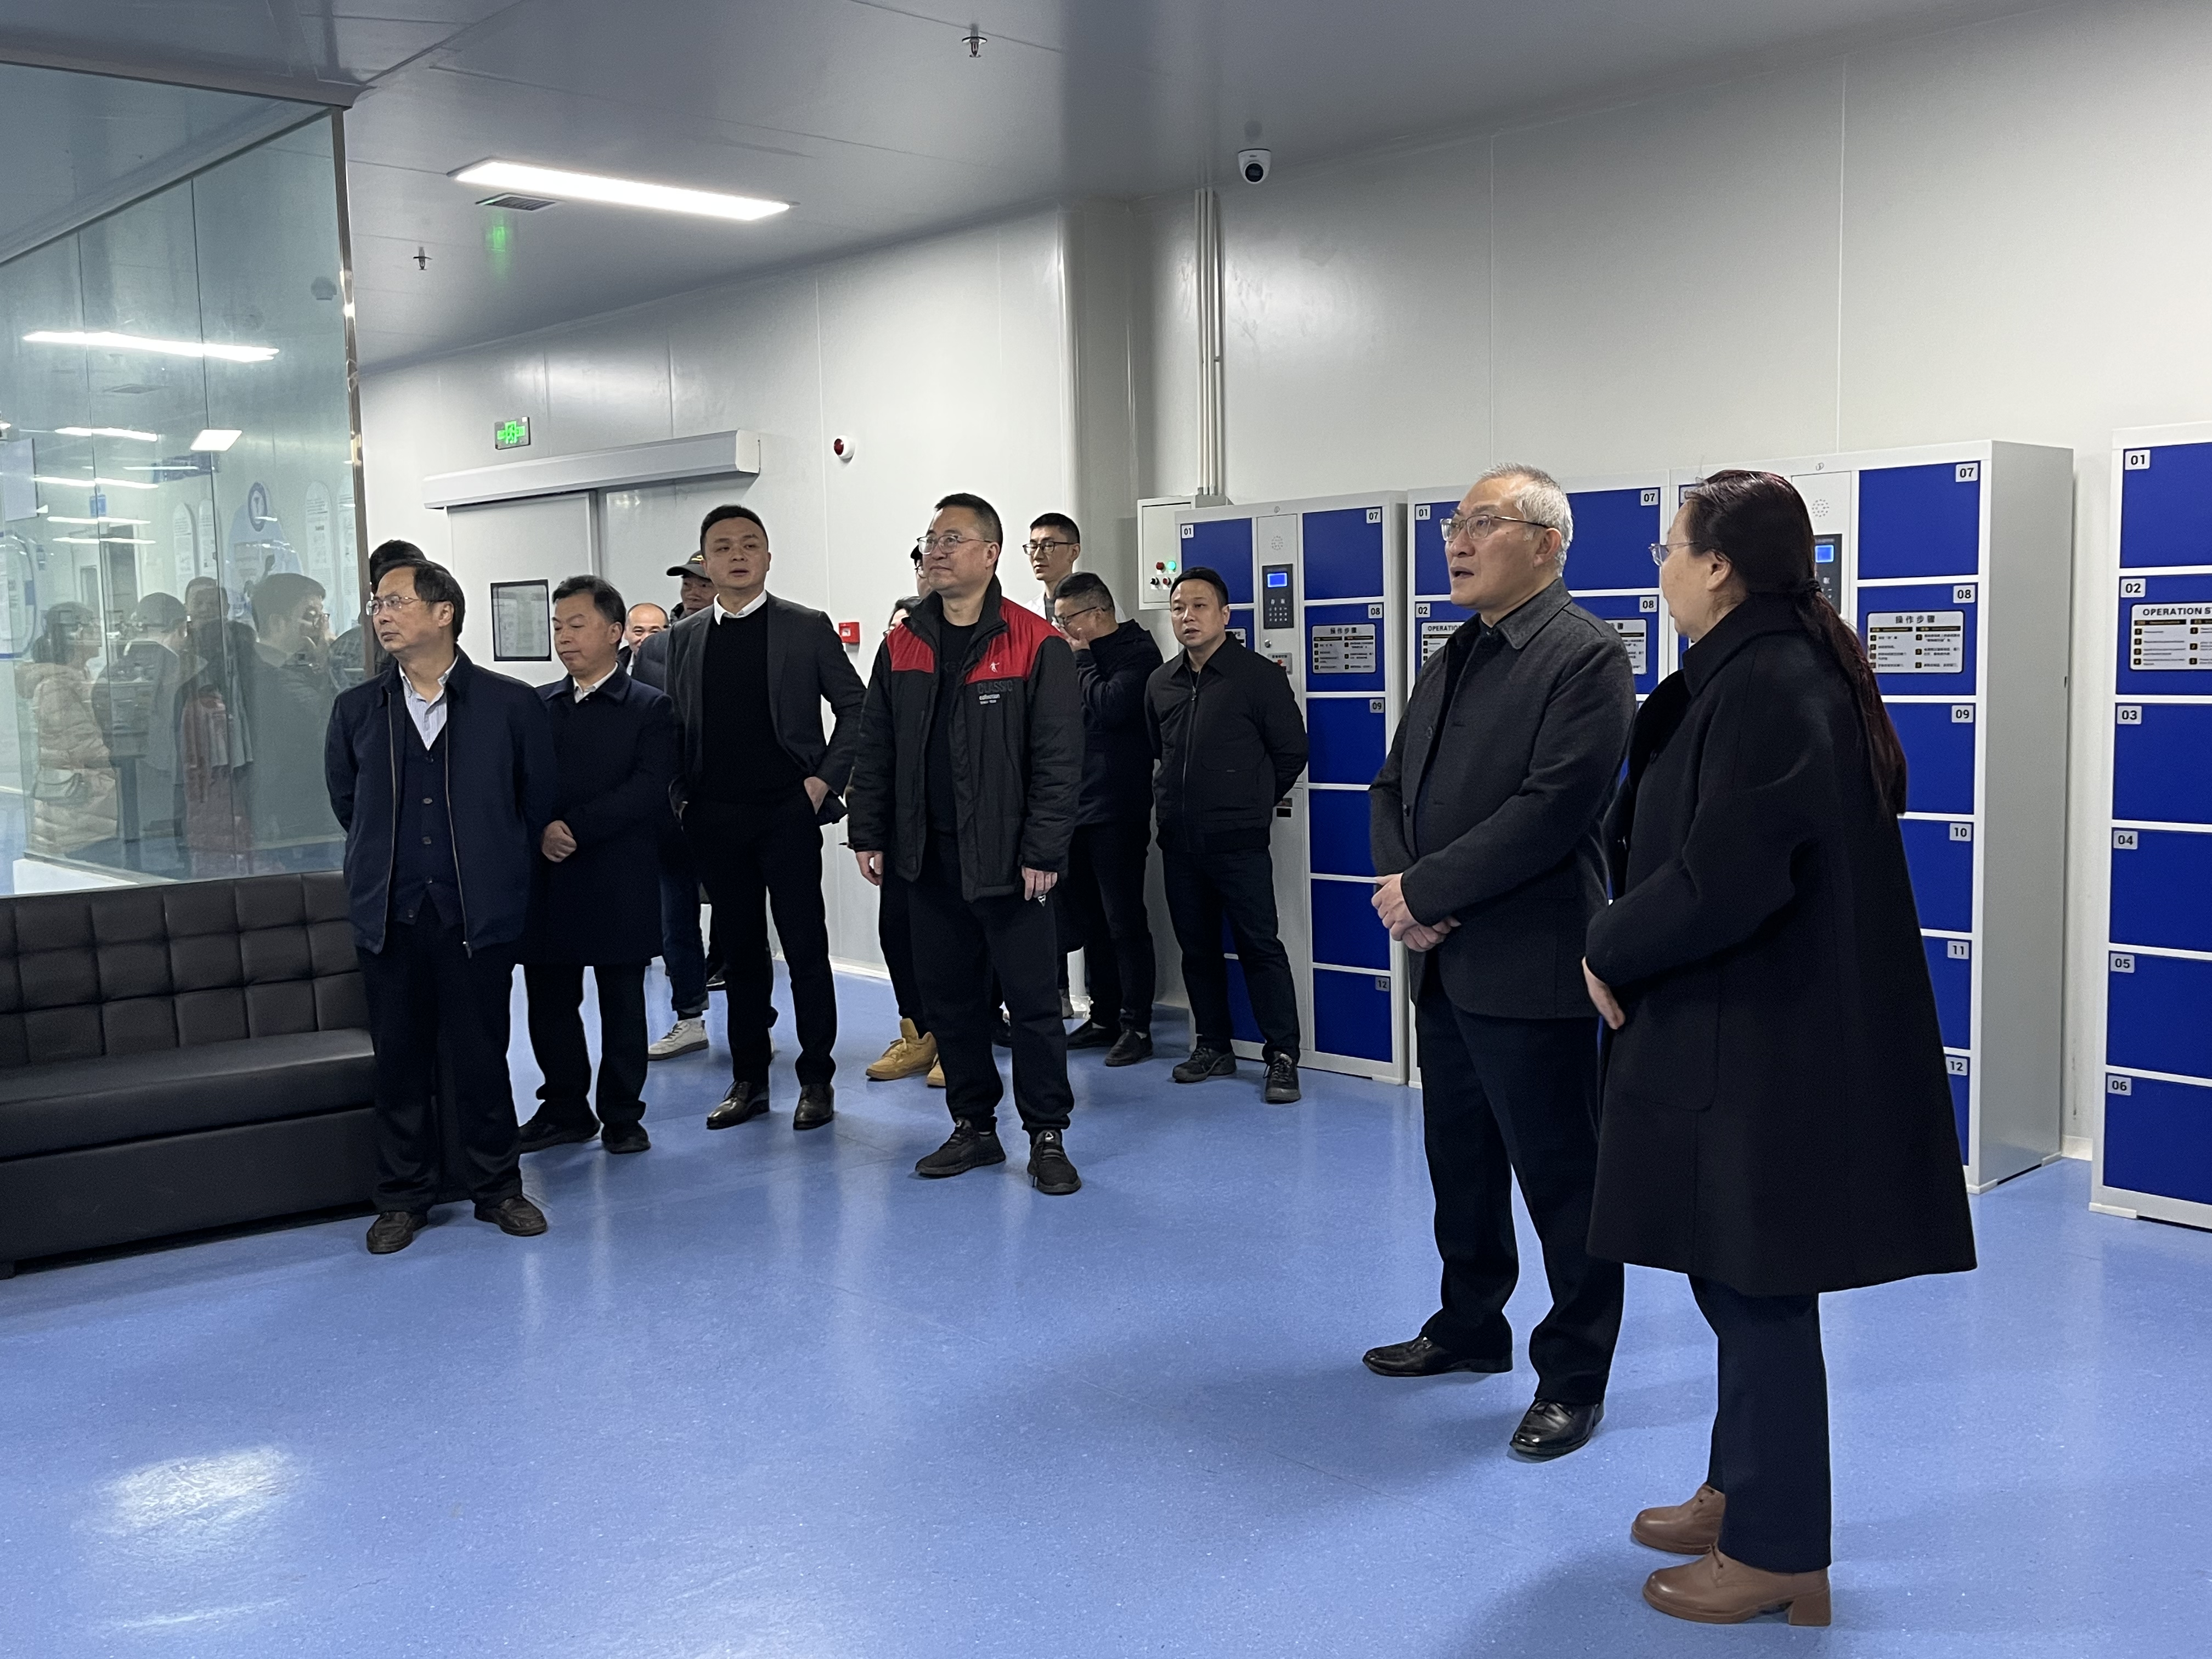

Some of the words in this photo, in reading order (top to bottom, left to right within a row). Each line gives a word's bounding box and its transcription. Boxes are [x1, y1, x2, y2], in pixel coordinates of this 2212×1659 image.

[2131, 454, 2145, 465] 01
[1960, 467, 1974, 478] 07
[1644, 493, 1655, 502] 07
[1369, 512, 1379, 520] 07
[1419, 509, 1427, 517] 01
[1184, 527, 1192, 535] 01
[2125, 583, 2141, 594] 02
[1957, 589, 1972, 599] 08
[1643, 600, 1654, 609] 08
[1370, 607, 1380, 616] 08
[1418, 606, 1428, 614] 02
[2142, 607, 2202, 616] OPERATION
[1372, 702, 1382, 710] 09
[1956, 709, 1970, 719] 09
[2121, 710, 2137, 720] 03
[1954, 827, 1967, 837] 10
[2118, 835, 2134, 845] 04
[1953, 945, 1964, 955] 11
[2115, 958, 2130, 969] 05
[1378, 980, 1387, 989] 12
[1950, 1061, 1963, 1071] 12
[2112, 1080, 2128, 1091] 06
